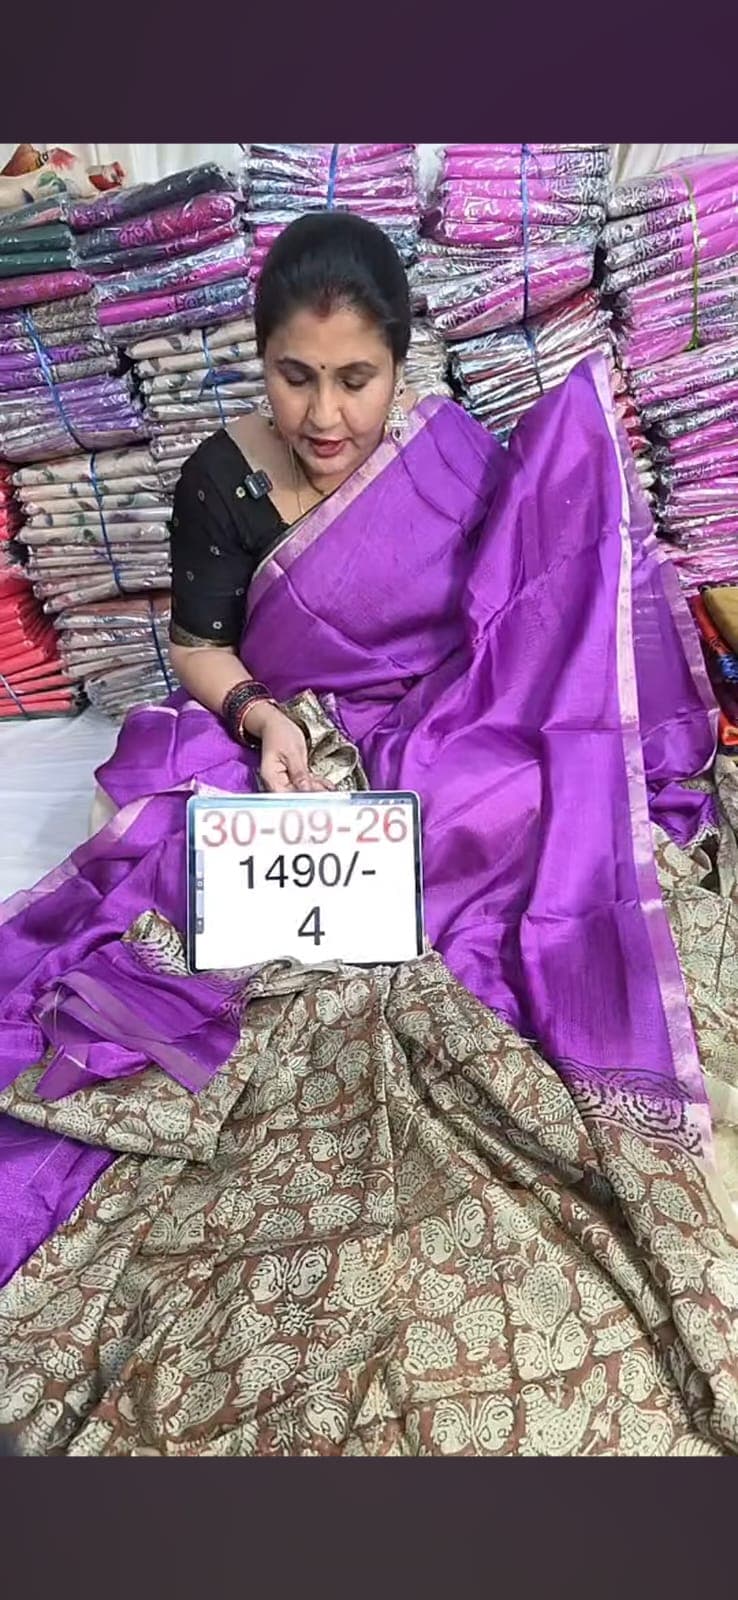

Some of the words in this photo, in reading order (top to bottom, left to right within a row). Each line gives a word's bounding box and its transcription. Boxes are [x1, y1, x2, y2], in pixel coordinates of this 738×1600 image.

[201, 806, 407, 847] 30-09-26
[239, 850, 376, 889] 1490/-
[297, 906, 325, 945] 4
